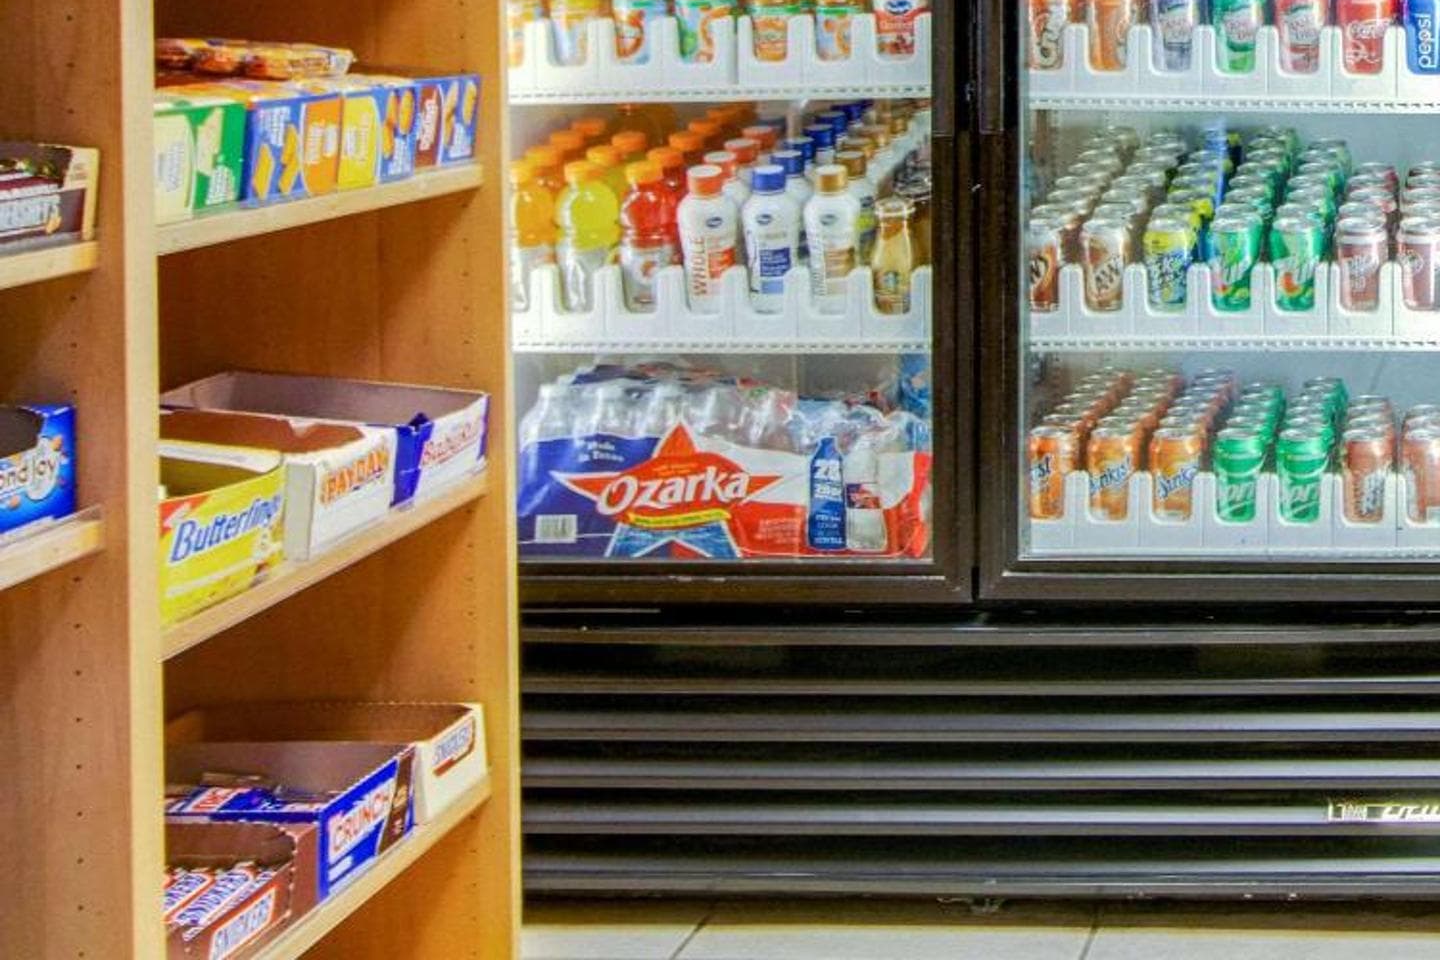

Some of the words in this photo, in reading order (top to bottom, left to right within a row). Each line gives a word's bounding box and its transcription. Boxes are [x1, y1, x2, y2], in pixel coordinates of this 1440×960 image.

[1418, 13, 1436, 69] pepsi
[322, 444, 389, 507] PAYDAY
[597, 470, 750, 515] Ozarka
[332, 788, 392, 852] CRUNCH
[213, 892, 269, 959] SNICKERS
